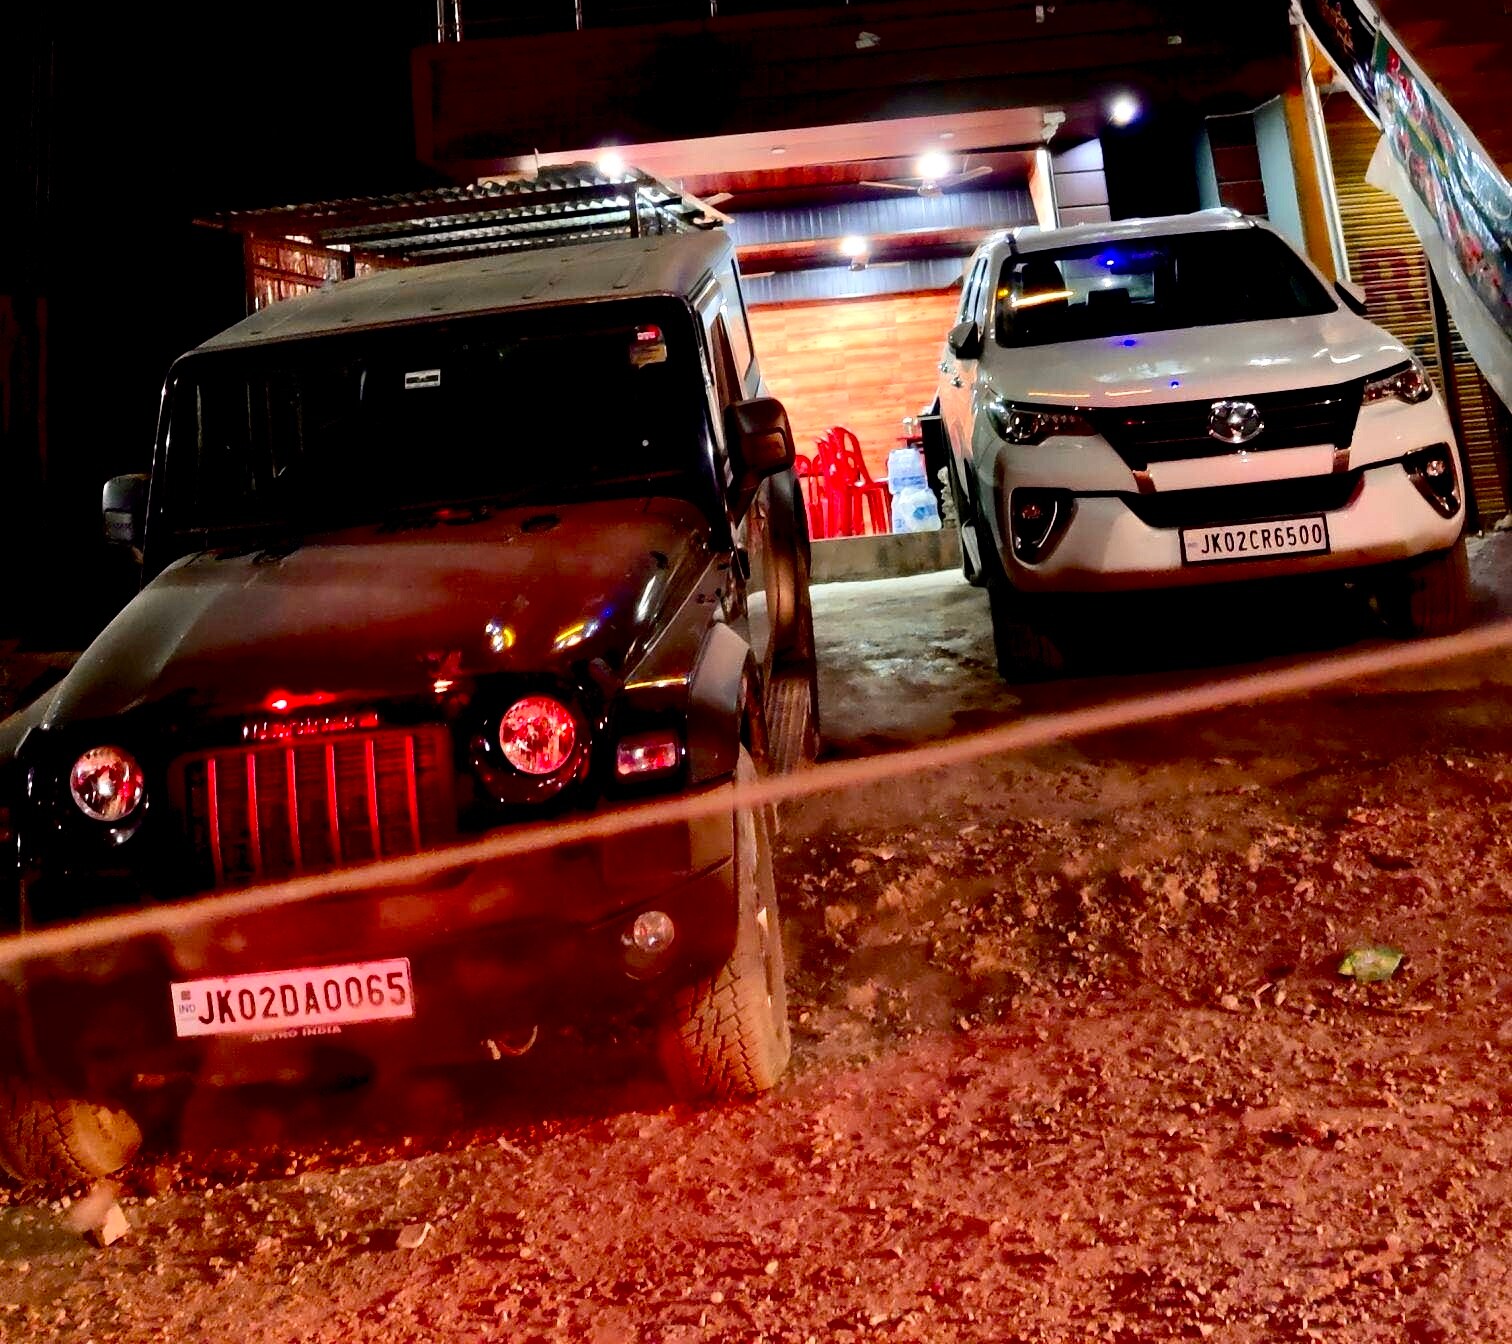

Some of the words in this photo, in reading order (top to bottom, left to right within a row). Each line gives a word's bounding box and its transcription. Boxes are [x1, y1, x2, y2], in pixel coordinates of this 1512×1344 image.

[1201, 524, 1322, 553] JK02CR6500
[198, 972, 406, 1025] JK02DA0065
[302, 1025, 342, 1037] INDIA
